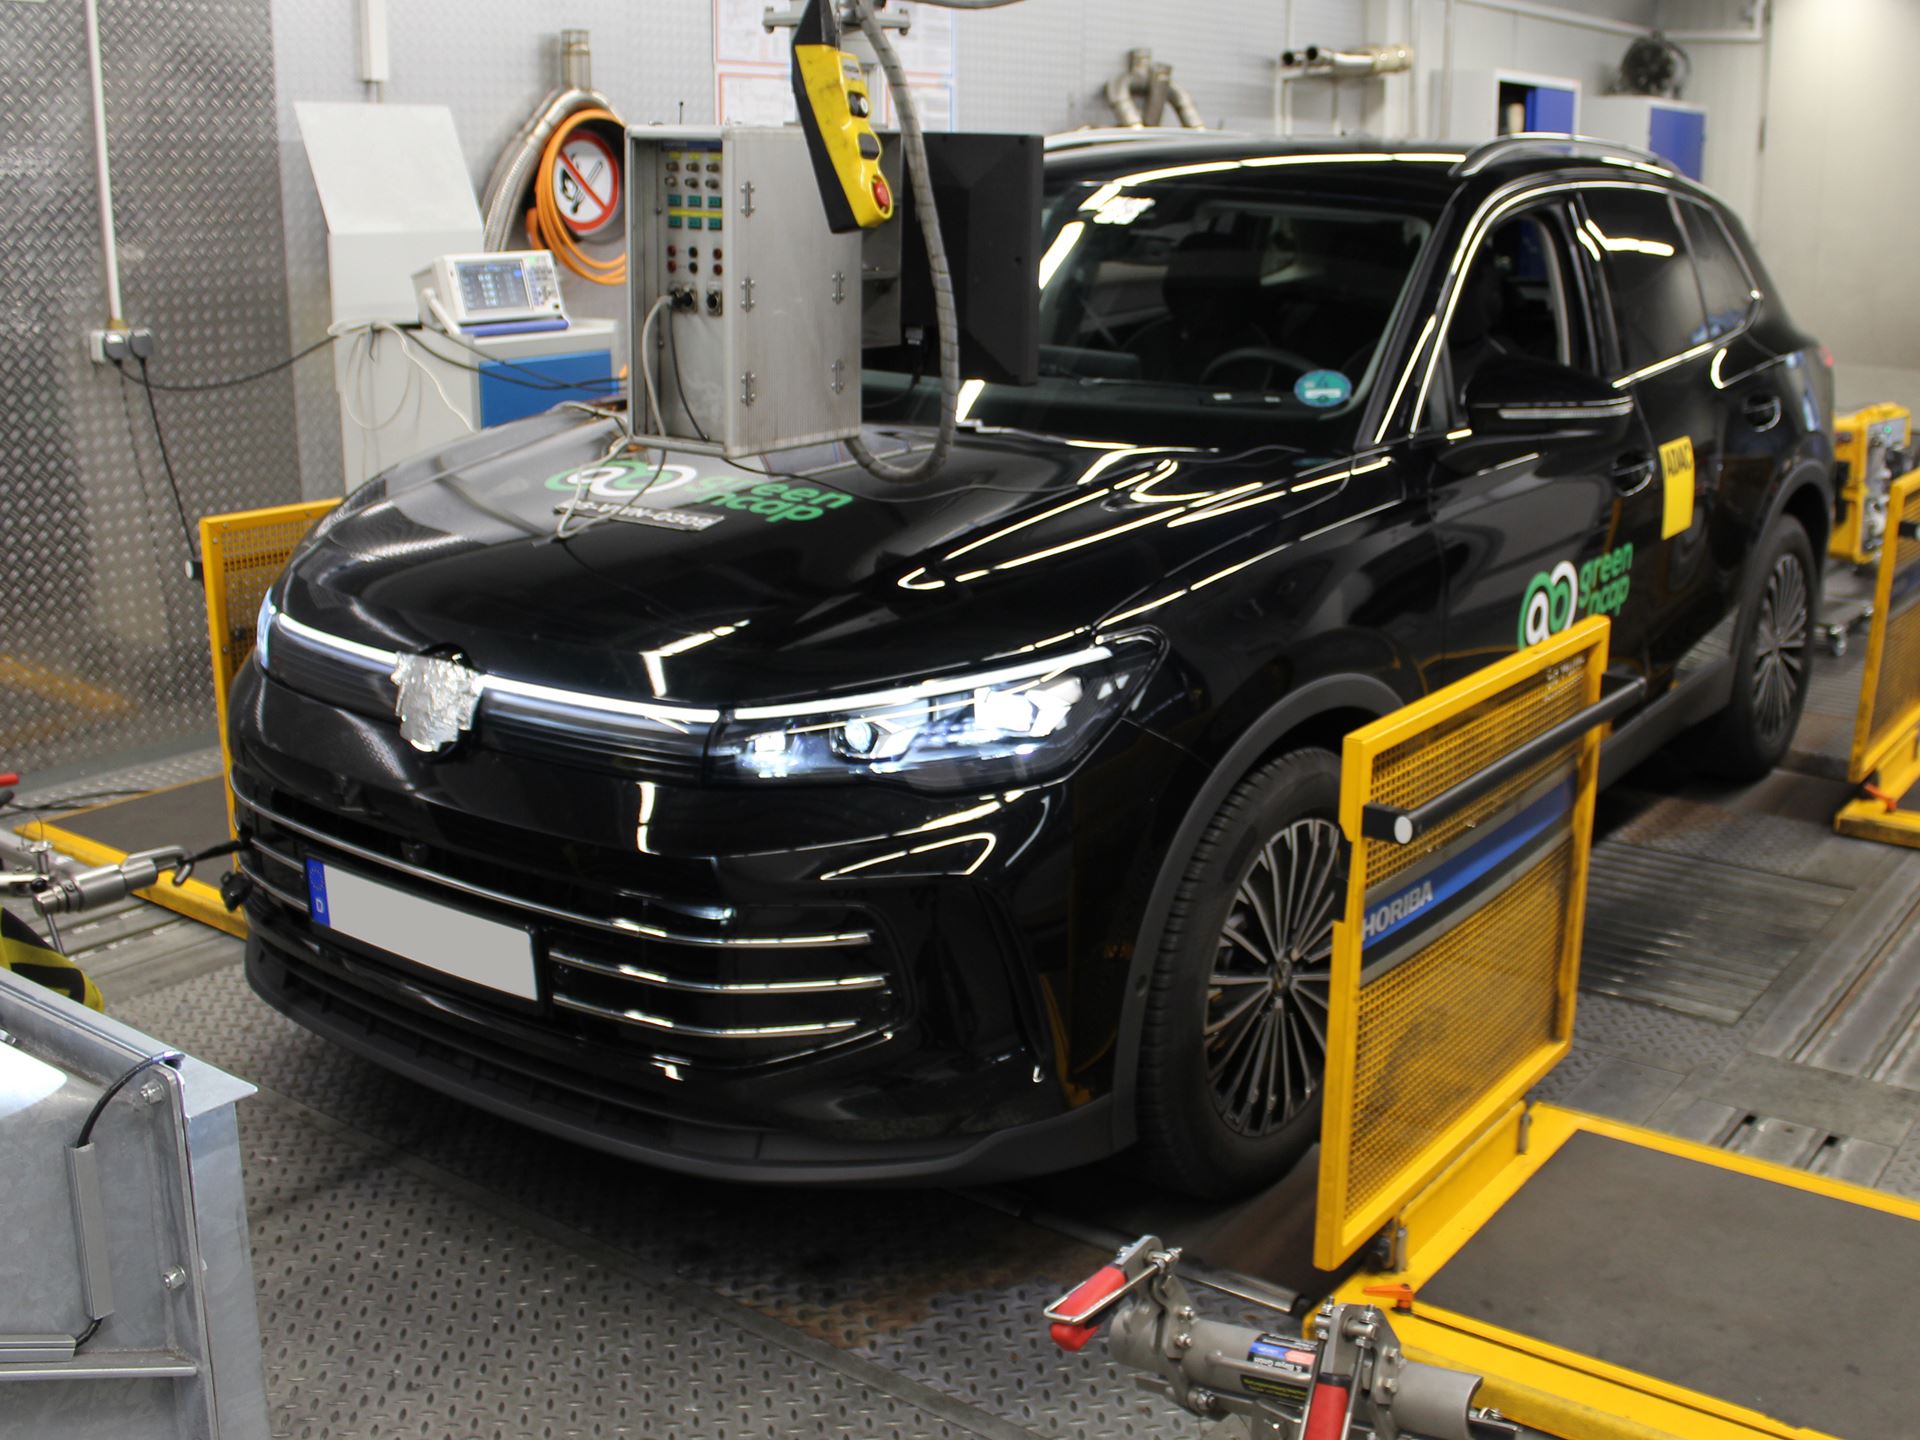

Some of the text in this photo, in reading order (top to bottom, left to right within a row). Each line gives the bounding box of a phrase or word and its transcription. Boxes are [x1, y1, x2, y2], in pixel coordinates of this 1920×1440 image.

[1666, 443, 1692, 477] ADAC
[684, 476, 853, 508] green
[697, 491, 823, 523] ncap
[1579, 542, 1633, 608] green
[1588, 575, 1630, 616] ncap
[315, 897, 324, 914] D
[1362, 881, 1433, 941] HORIBA
